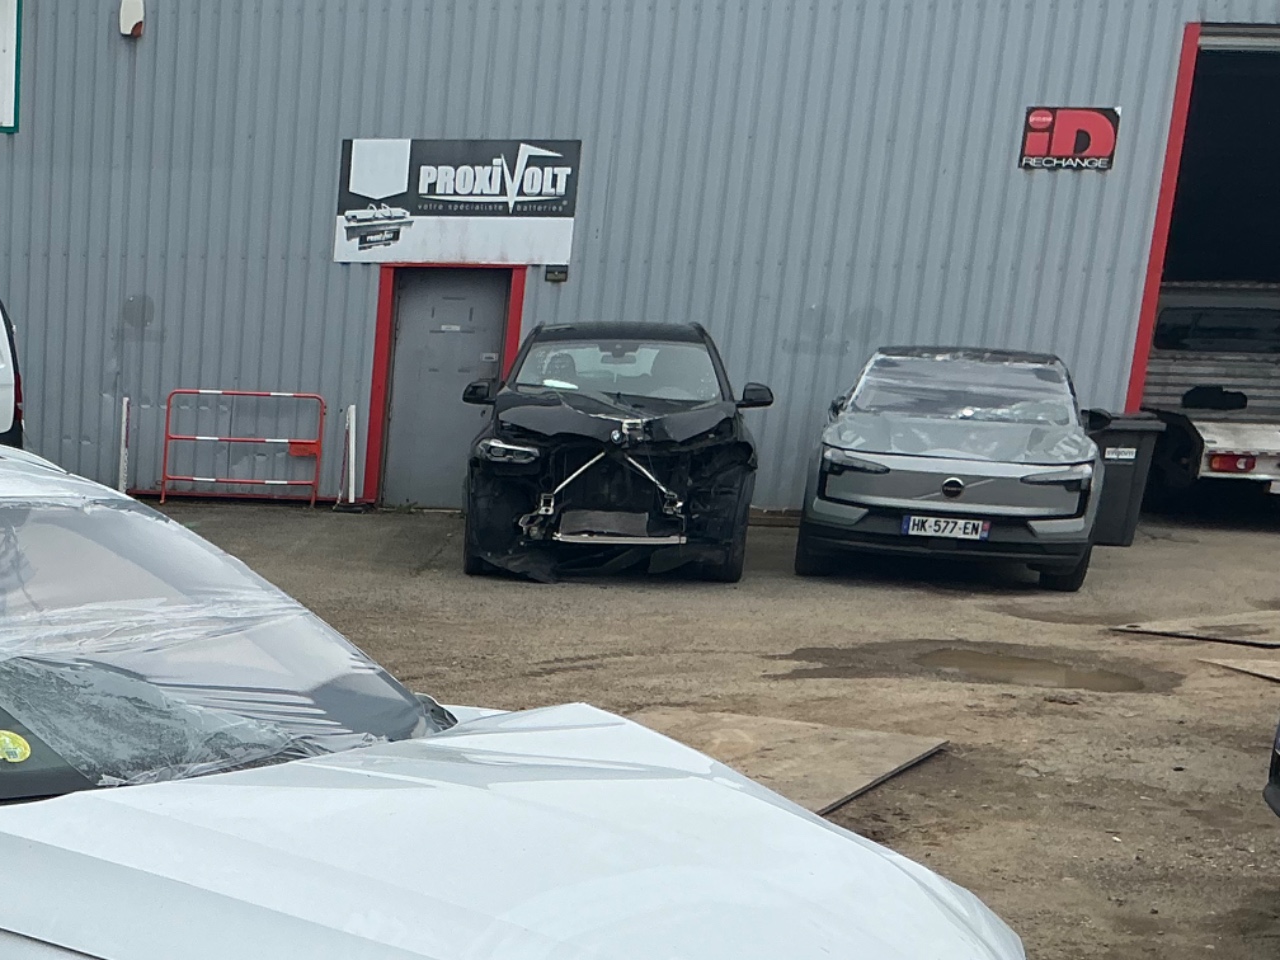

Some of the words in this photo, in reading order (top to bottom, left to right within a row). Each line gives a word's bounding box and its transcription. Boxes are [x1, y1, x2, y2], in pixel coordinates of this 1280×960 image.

[1021, 156, 1109, 168] RECHANGE
[417, 203, 443, 211] votre
[911, 519, 980, 536] HK-577-EN
